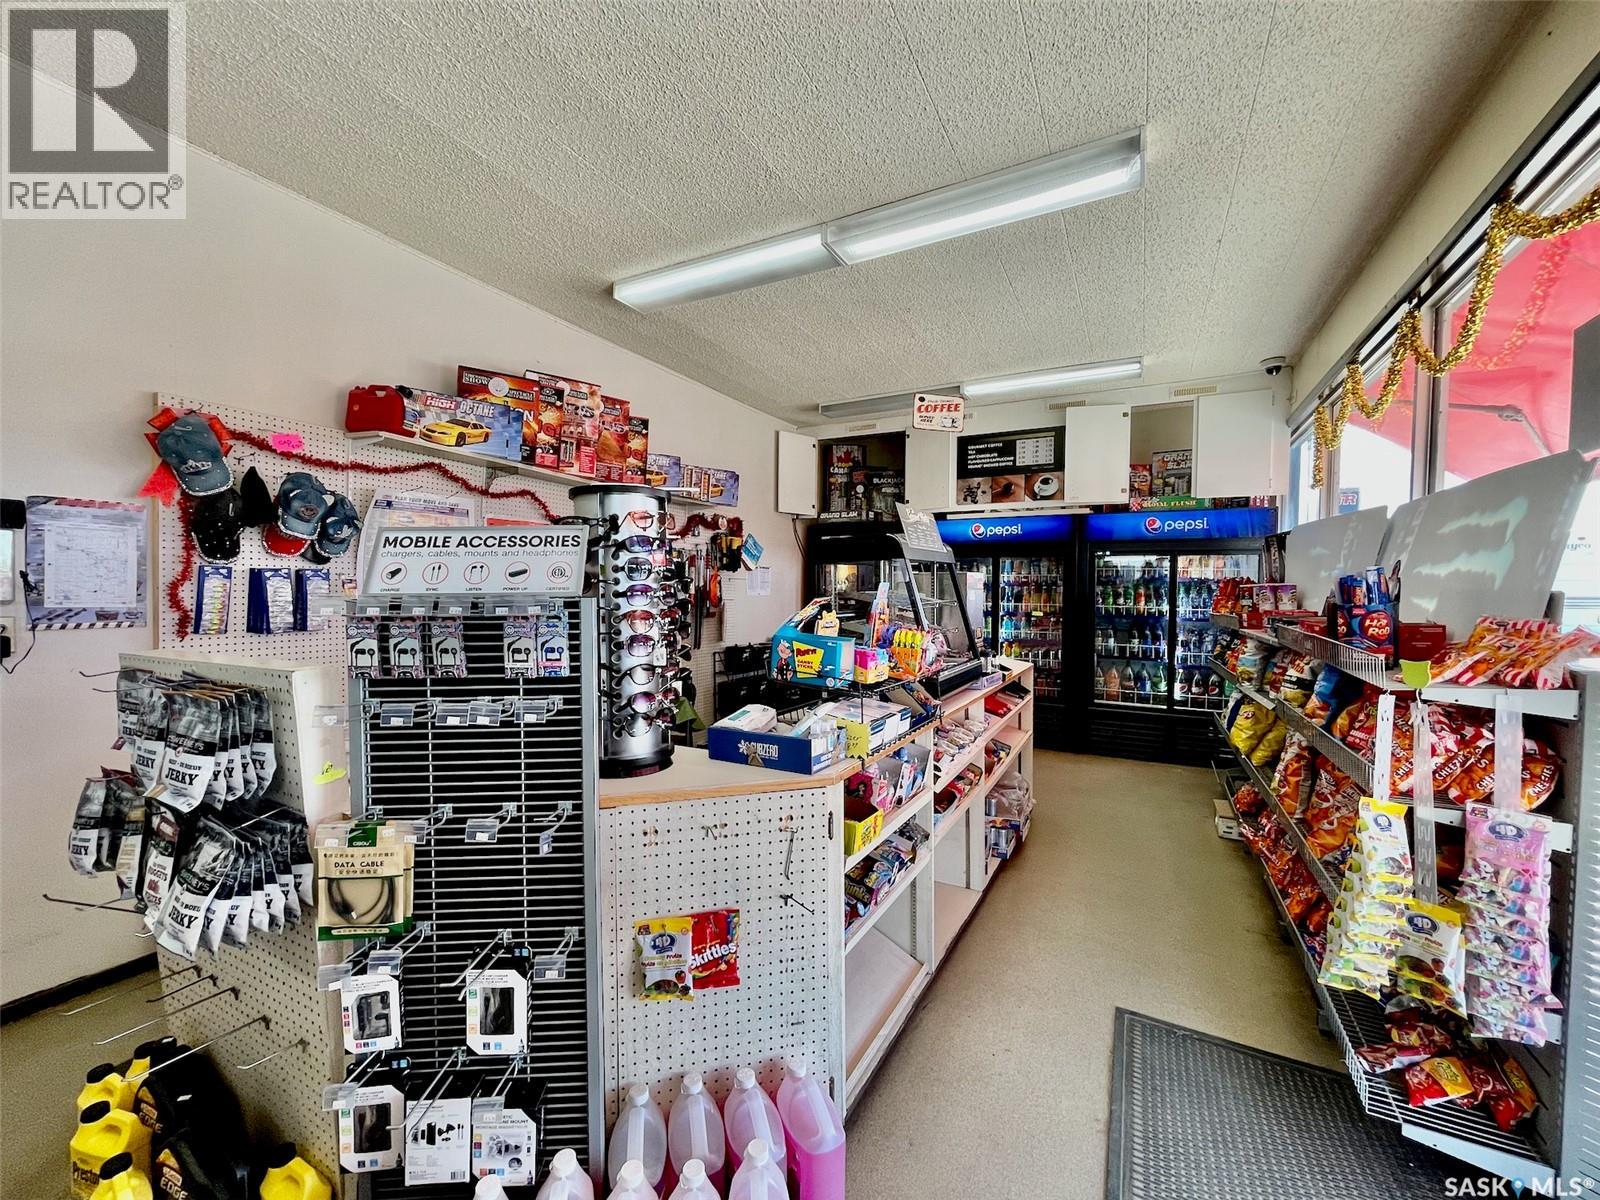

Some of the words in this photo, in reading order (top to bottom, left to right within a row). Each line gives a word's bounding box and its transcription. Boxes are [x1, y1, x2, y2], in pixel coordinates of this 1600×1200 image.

[426, 396, 456, 410] HIGH
[460, 400, 495, 418] OCTANE
[917, 403, 961, 413] COFFEE
[1164, 453, 1192, 462] GRAN
[986, 523, 1021, 538] pepsi
[1164, 518, 1209, 532] pepsi
[382, 536, 451, 549] MOBILE
[456, 535, 581, 549] ACCESSORIES
[381, 550, 423, 559] chargers,
[427, 550, 459, 558] cables,
[464, 550, 499, 558] mounts
[501, 550, 519, 558] and
[522, 549, 579, 558] headphones
[136, 754, 156, 769] JERKY
[165, 767, 200, 786] JERKY
[360, 860, 384, 868] CABLE
[168, 905, 199, 929] JERKY
[689, 942, 737, 970] Skittles
[138, 1111, 164, 1134] EDGE
[160, 1176, 188, 1200] EDGE
